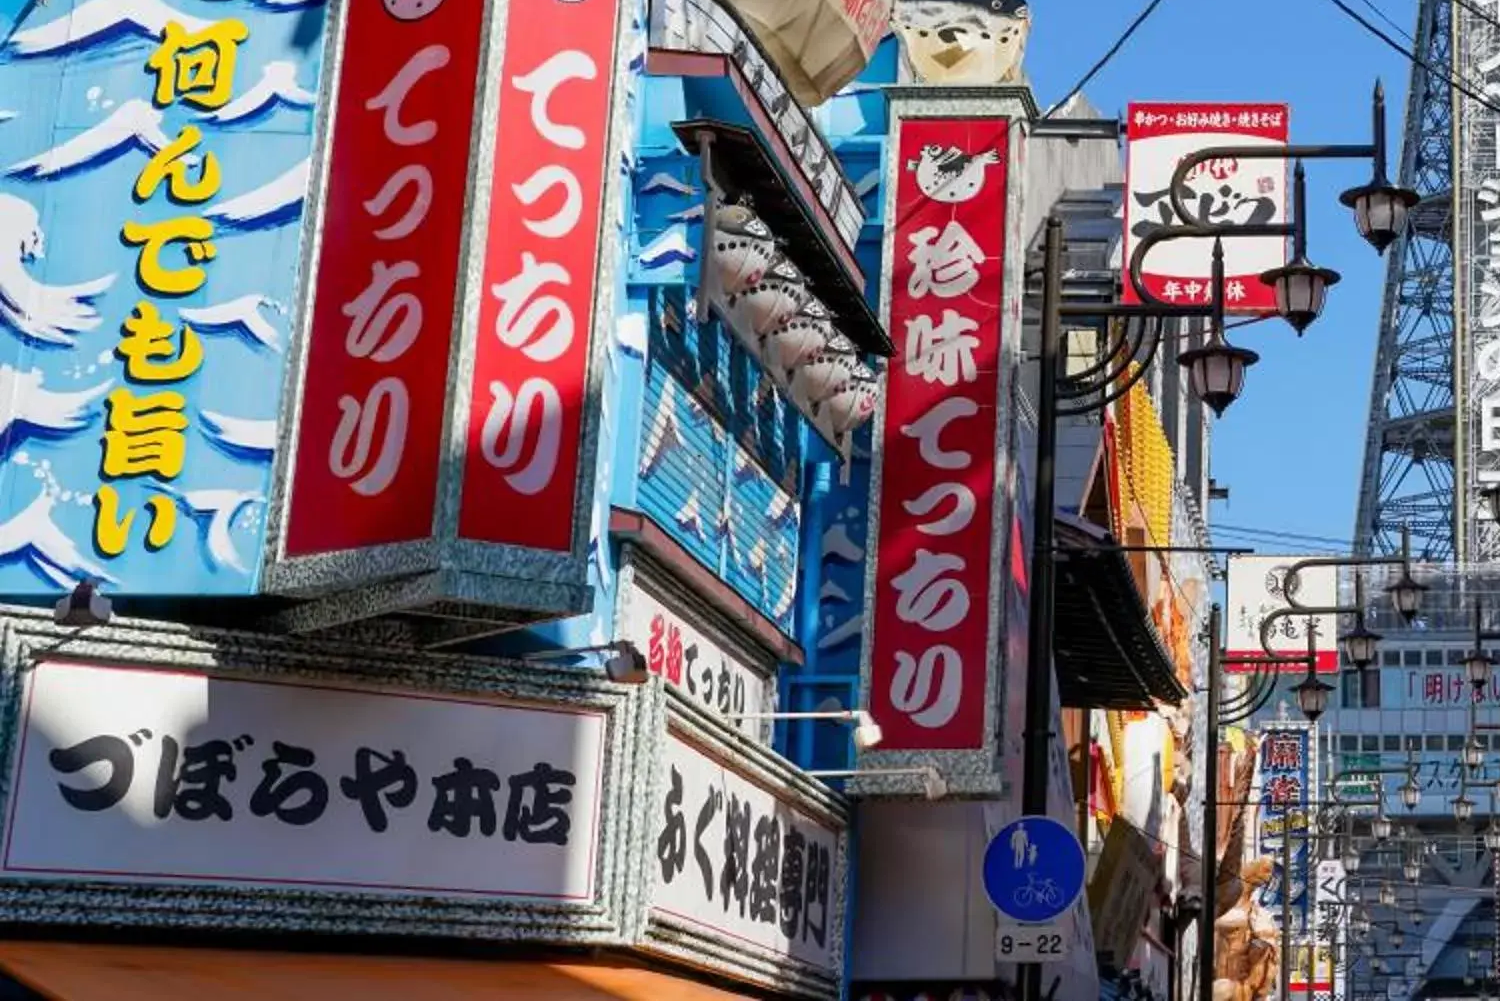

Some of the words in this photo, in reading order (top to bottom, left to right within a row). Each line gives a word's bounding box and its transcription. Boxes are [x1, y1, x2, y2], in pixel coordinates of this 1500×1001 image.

[49, 728, 577, 846] づぼらや本店
